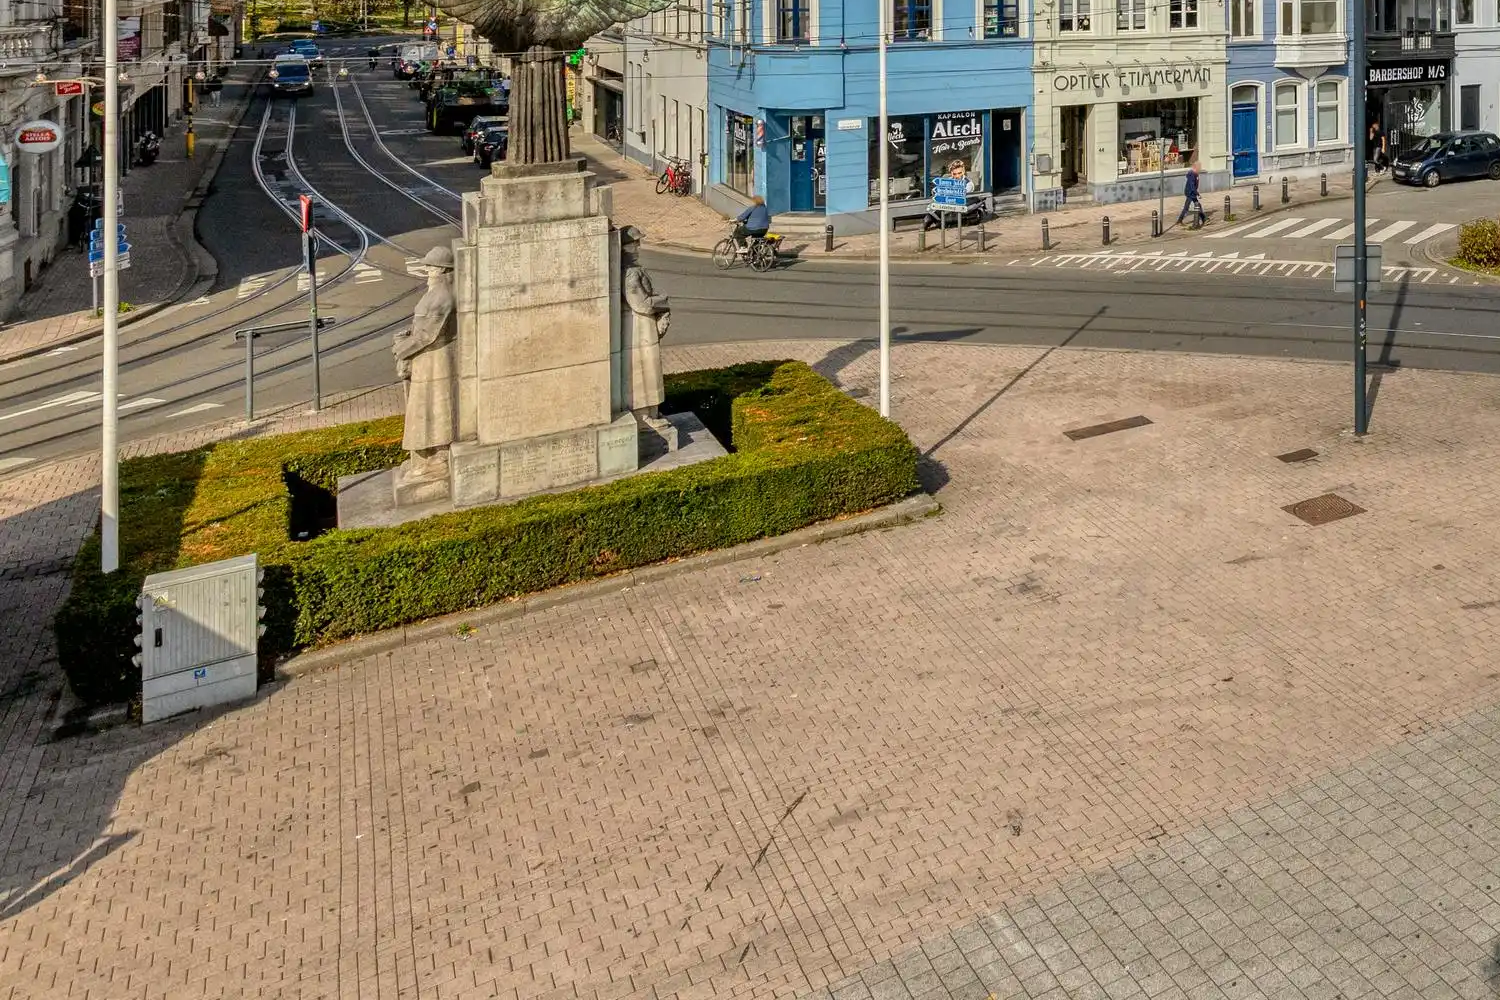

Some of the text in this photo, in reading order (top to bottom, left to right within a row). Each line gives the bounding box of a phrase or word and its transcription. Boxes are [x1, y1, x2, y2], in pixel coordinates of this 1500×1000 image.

[1054, 73, 1110, 91] OPTIEK
[1369, 65, 1445, 82] BARBERSHOP M/S
